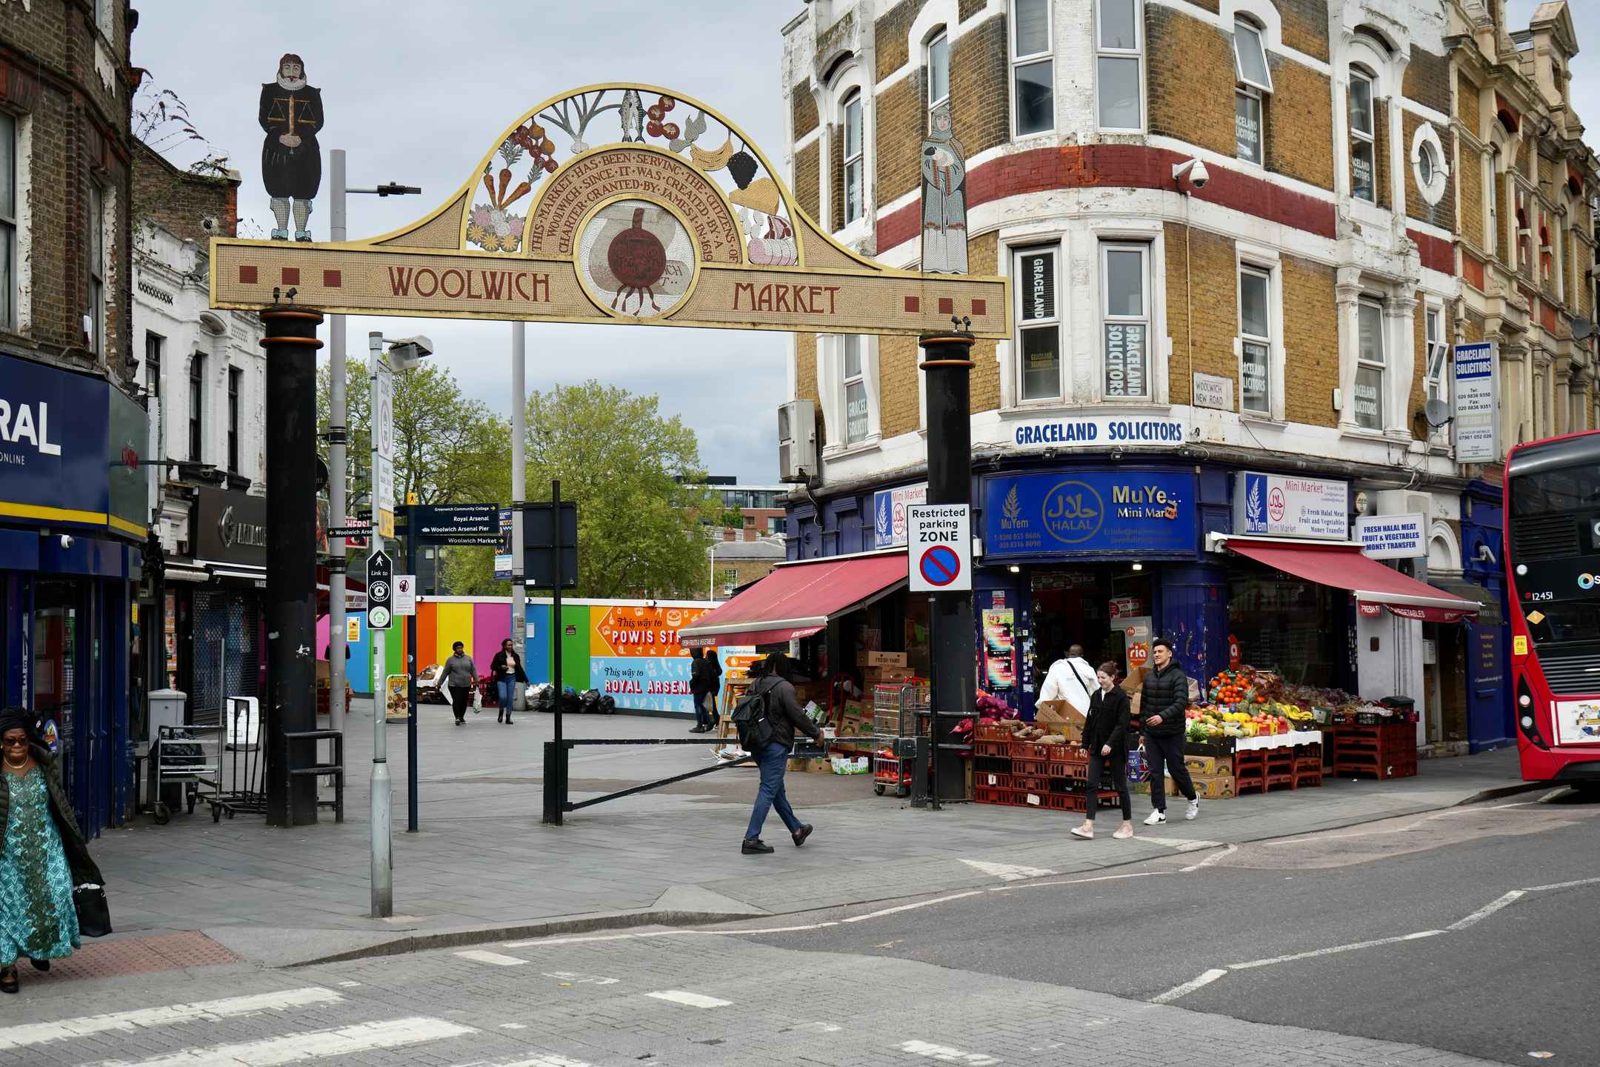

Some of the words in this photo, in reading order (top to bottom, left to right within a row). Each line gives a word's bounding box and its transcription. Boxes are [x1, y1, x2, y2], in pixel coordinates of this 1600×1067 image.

[532, 223, 544, 252] THIS
[540, 175, 572, 220] MARKET
[574, 160, 598, 178] HAS
[601, 153, 632, 166] BEEN
[636, 154, 682, 176] SERVING
[684, 173, 707, 191] THE
[706, 194, 736, 245] CITIZENS
[728, 250, 739, 262] OF
[547, 188, 581, 238] WOOLWICH
[584, 170, 614, 188] SINCE
[618, 166, 630, 176] IT
[636, 166, 661, 182] WAS
[664, 176, 709, 216] CREATED
[706, 218, 720, 236] BY
[713, 240, 724, 250] A
[559, 204, 586, 254] CHARTER
[643, 182, 658, 194] BY
[660, 187, 693, 216] JAMES
[694, 223, 707, 236] IN
[388, 266, 550, 302] WOOLWICH
[733, 282, 841, 314] MARKET
[1034, 258, 1045, 318] GRACELAND
[1108, 325, 1124, 396] SOLICITORS
[1126, 326, 1142, 396] GRACELAND
[1456, 348, 1490, 362] GRACELAND
[1456, 362, 1492, 374] SOLICITORS
[1016, 423, 1098, 444] GRACELAND
[1108, 422, 1182, 442] SOLICITORS
[0, 452, 25, 466] ONLINE
[1285, 480, 1299, 491] Mini
[1301, 482, 1323, 494] Market
[1112, 486, 1168, 504] MuYe
[912, 508, 966, 518] Restricted
[1048, 494, 1098, 518] حلال
[1118, 506, 1142, 518] Mini
[1145, 508, 1166, 518] Mar
[920, 520, 958, 530] parking
[1001, 518, 1028, 529] MuYem
[1052, 520, 1092, 530] HALAL
[920, 531, 958, 542] ZONE
[1385, 532, 1419, 541] VEGETABLES
[1387, 542, 1416, 550] TRANSFER
[1532, 592, 1553, 600] 12451
[617, 617, 636, 629] This
[638, 619, 653, 629] way
[654, 618, 662, 626] to
[612, 630, 654, 645] POWIS
[660, 630, 681, 644] STR
[1130, 645, 1146, 658] ria
[604, 666, 621, 678] This
[622, 668, 635, 678] way
[636, 668, 644, 677] to
[604, 680, 642, 694] ROYAL
[648, 680, 692, 695] ARSEN
